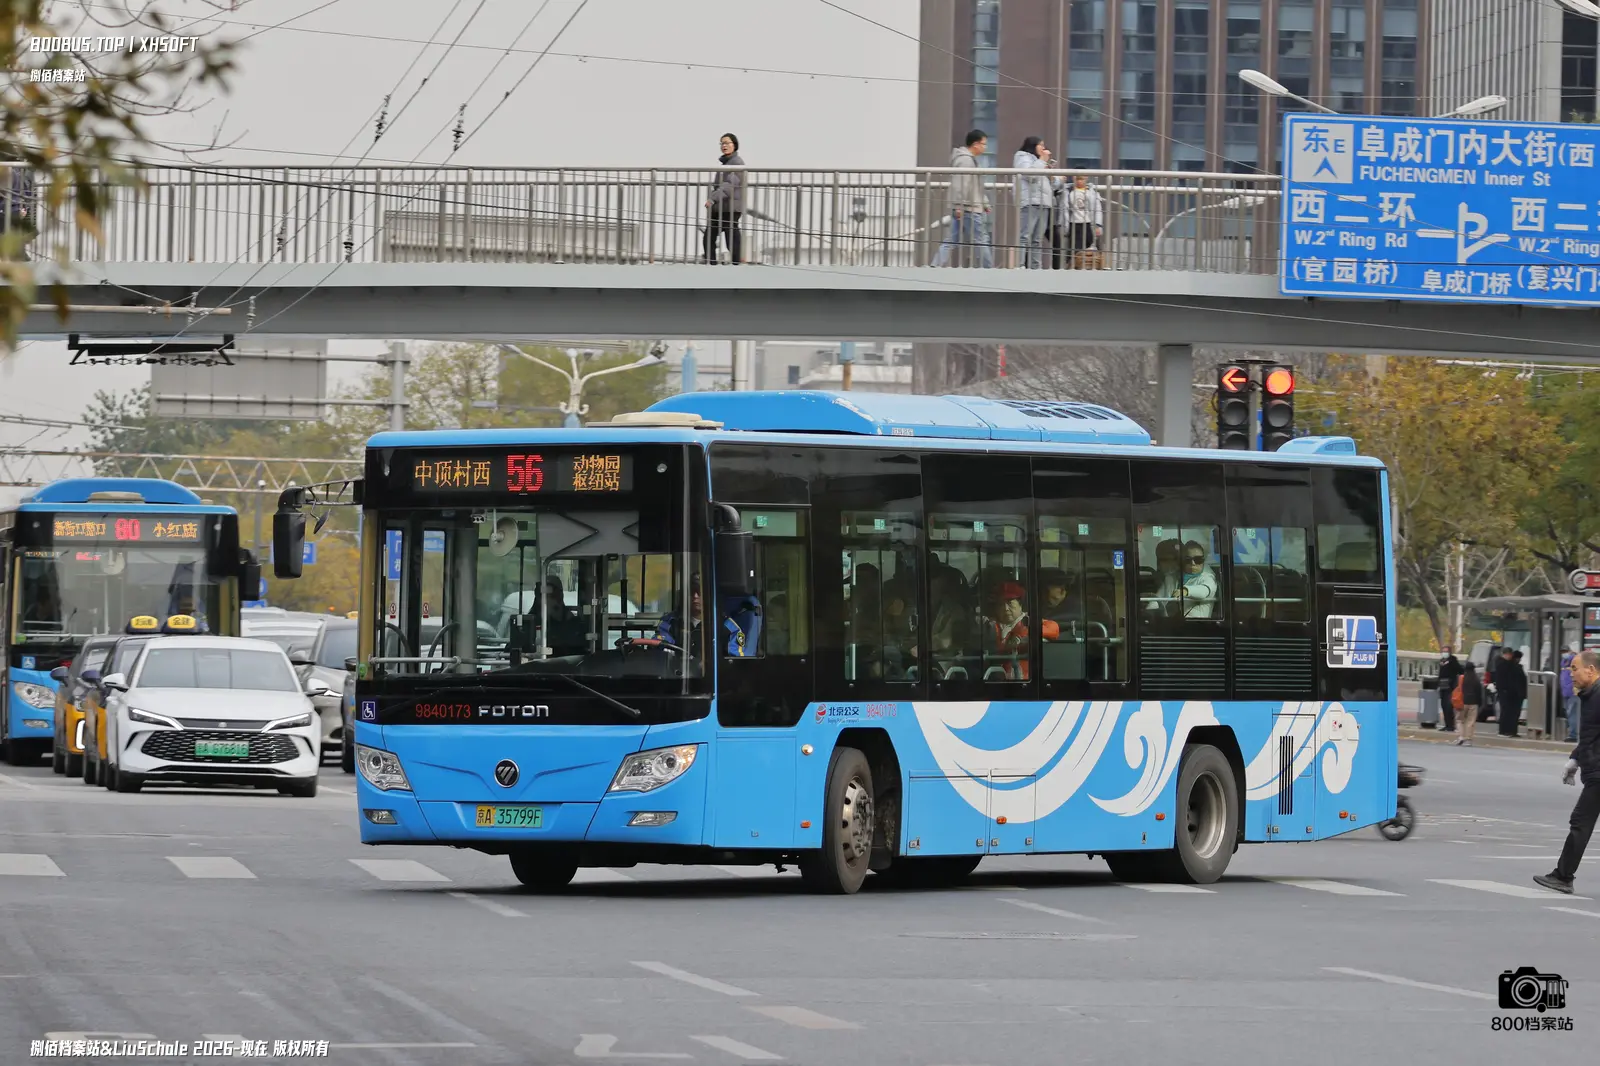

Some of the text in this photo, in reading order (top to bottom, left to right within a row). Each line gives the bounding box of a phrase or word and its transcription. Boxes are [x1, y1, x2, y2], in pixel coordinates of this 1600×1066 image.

[1360, 166, 1551, 187] FUCHENGMEN Inner St
[1290, 188, 1417, 228] 西二环
[1510, 197, 1600, 232] 西二
[1339, 231, 1377, 250] Ring
[1385, 232, 1408, 248] Rd
[1563, 239, 1600, 258] Ring
[1420, 268, 1512, 296] 阜成门桥
[1517, 264, 1600, 294] (复兴门
[507, 454, 544, 492] 56
[573, 455, 621, 473] 动物园
[415, 460, 492, 488] 中顶村西
[573, 473, 621, 492] 枢纽站
[415, 703, 471, 719] 9840173
[478, 705, 549, 717] FOTON
[828, 706, 860, 717] 北京公交
[866, 703, 897, 717] 9840173
[477, 808, 541, 825] 京A 35799F
